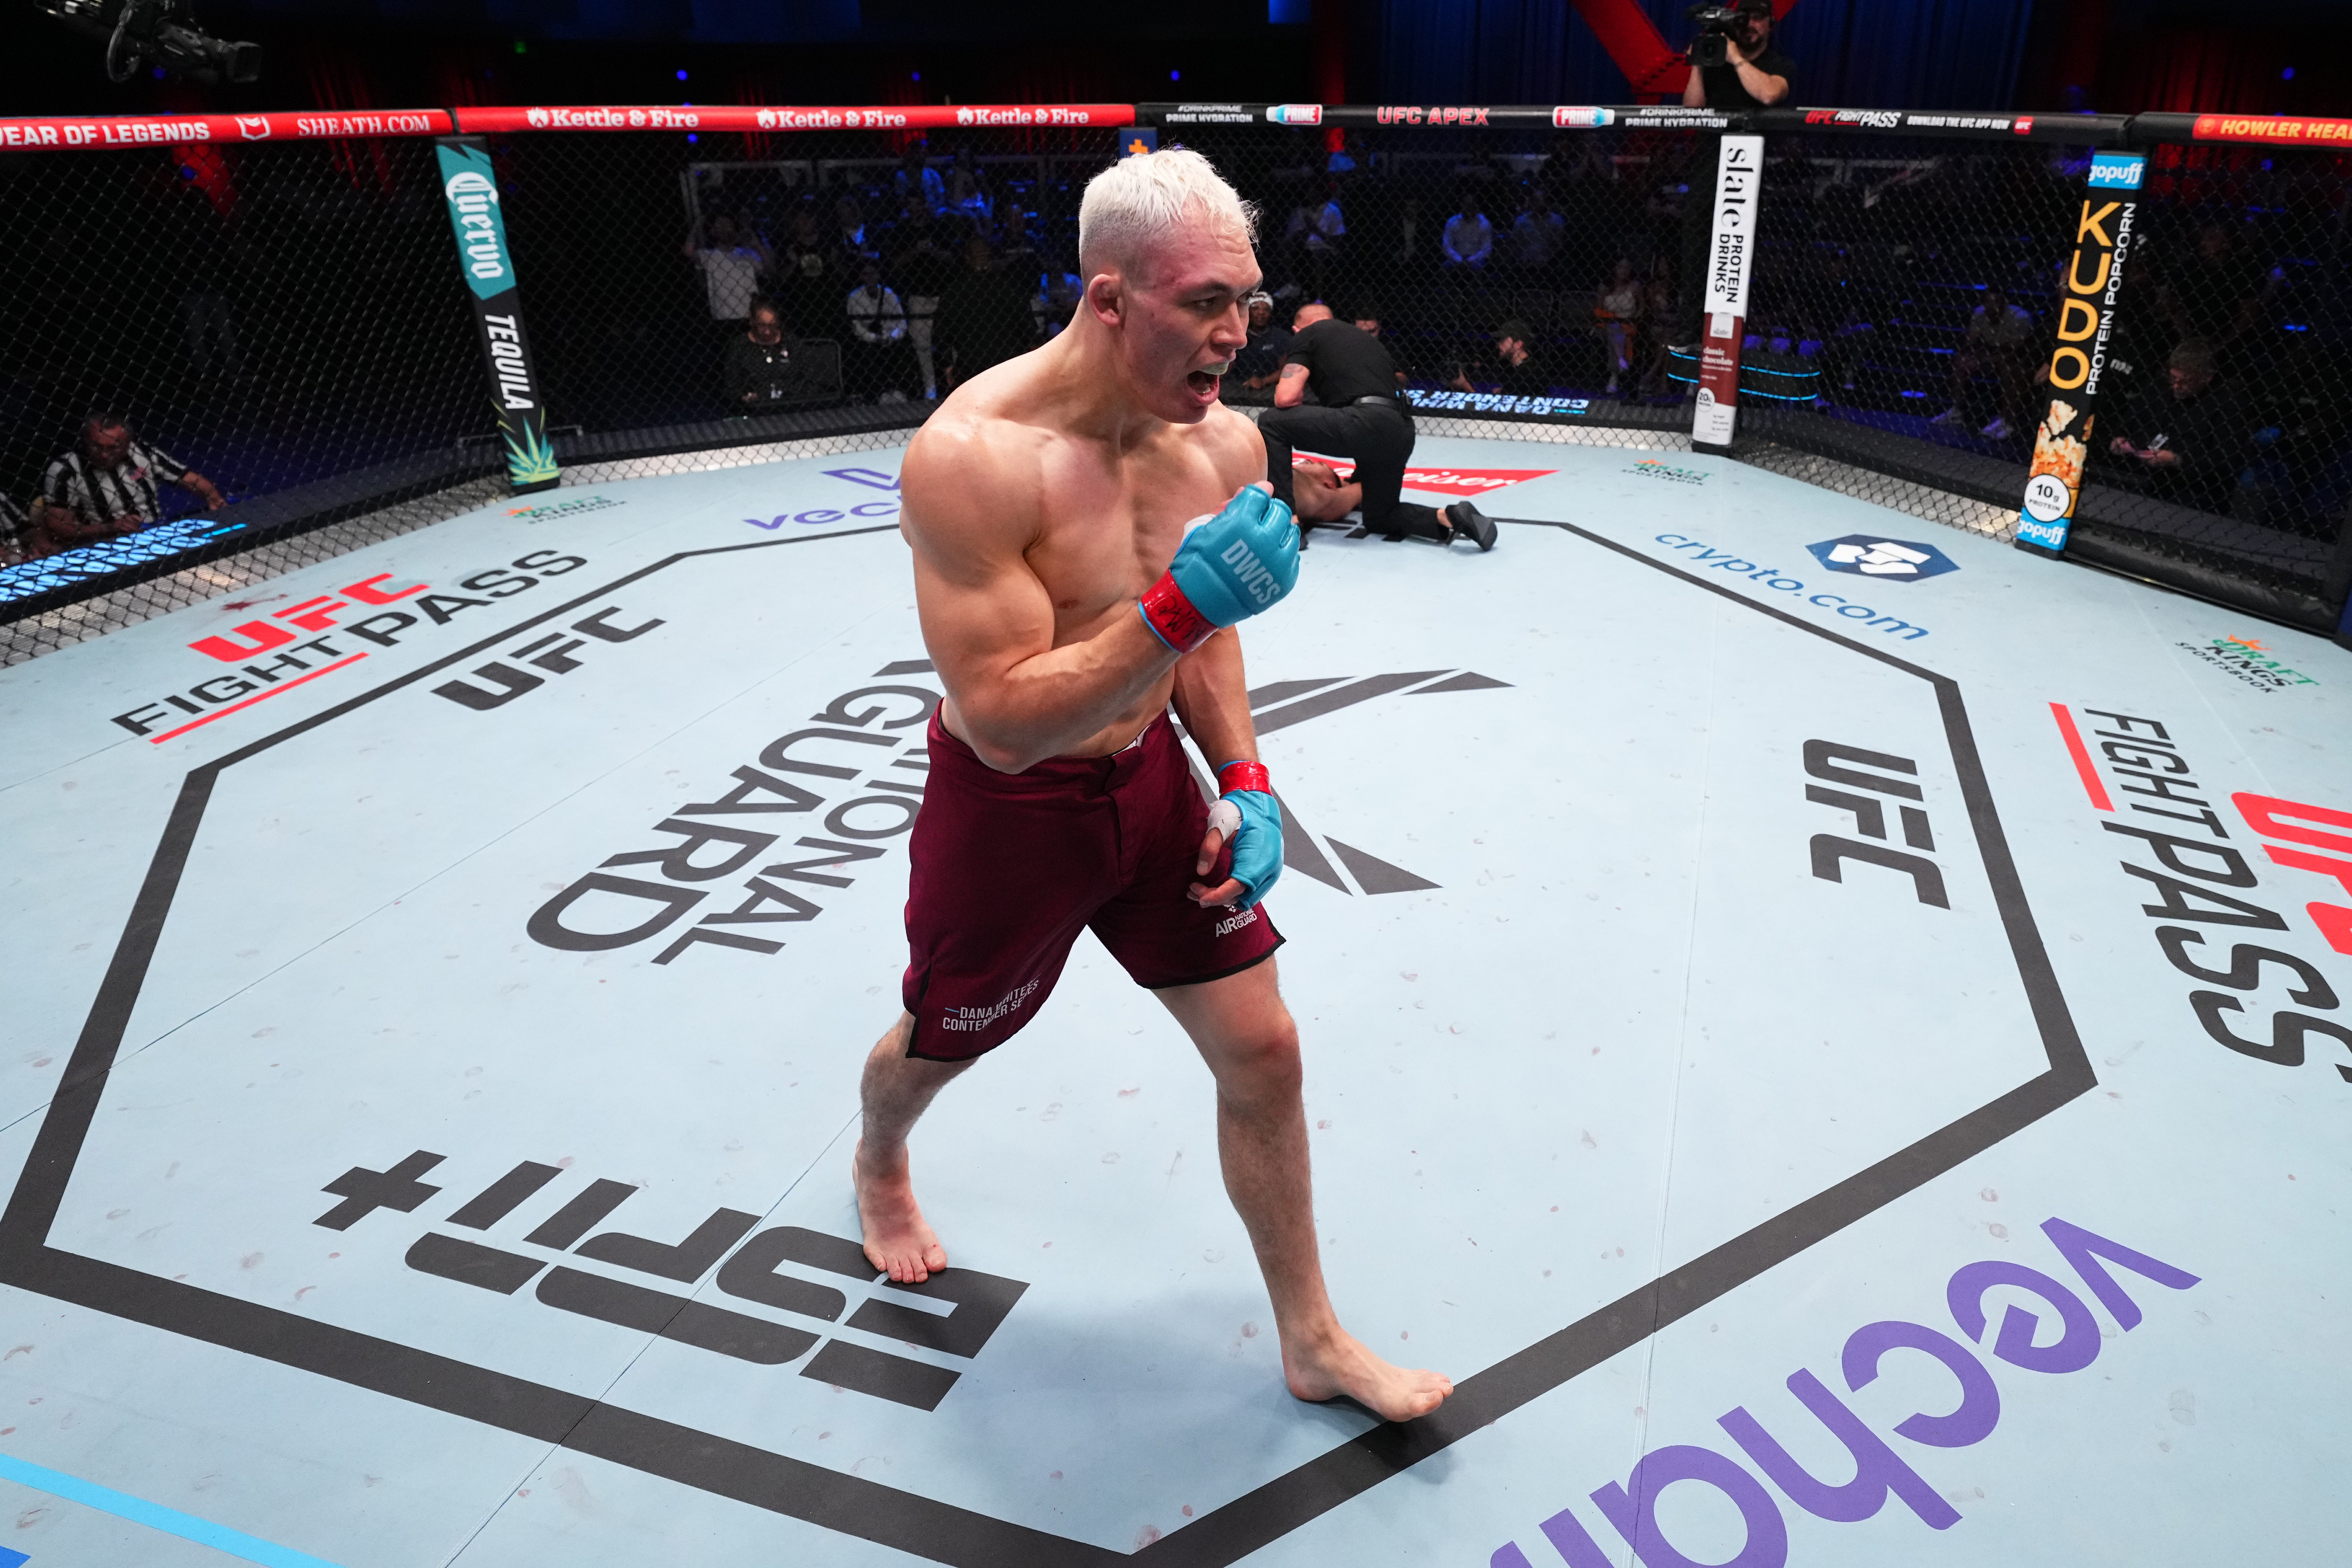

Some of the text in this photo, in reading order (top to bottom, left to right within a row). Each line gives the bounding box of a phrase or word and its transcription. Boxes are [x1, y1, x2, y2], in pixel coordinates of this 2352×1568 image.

[0, 122, 210, 146] EAR OF LEGENDS
[297, 115, 431, 137] SHEATH.COM
[550, 108, 699, 127] Kettle & Fire
[777, 110, 907, 128] Kettle & Fire
[975, 108, 1088, 125] Kettle & Fire
[1165, 113, 1253, 123] PRIME HYDRATION
[1284, 107, 1318, 122] PRIME
[1377, 106, 1489, 126] UFC APEX
[1561, 109, 1596, 125] PRIME
[1625, 118, 1728, 128] PRIME HYDRATION
[1805, 111, 1902, 128] UFC FIGHT PASS
[2220, 120, 2302, 138] HOWLER
[1721, 148, 1753, 227] slate
[446, 171, 504, 279] Cuervo
[1715, 234, 1730, 293] DRINKS
[1727, 235, 1744, 303] PROTEIN
[2049, 200, 2122, 390] KUDO
[2086, 203, 2137, 395] PROTEIN POPCORN
[485, 314, 534, 409] TEQUILA
[2029, 499, 2061, 512] PROTEIN
[1220, 538, 1281, 604] DWCS
[1655, 534, 1929, 640] crypto.com
[188, 572, 430, 663] UFC
[109, 550, 588, 737] FIGHT PASS
[430, 605, 667, 711] UFC
[2203, 646, 2293, 686] KINGS
[2212, 639, 2320, 685] DRAFT
[2174, 642, 2277, 693] SPORTSBOOK
[527, 685, 943, 952] GUARD
[1803, 739, 1951, 910] UFC
[651, 748, 930, 966] IONAL
[1235, 907, 1254, 921] NATIONAL
[2084, 708, 2352, 1083] FIGHT PASS
[1216, 917, 1238, 938] AIR
[1237, 913, 1257, 928] GUARD
[943, 1004, 1008, 1032] CONTENDER
[960, 1007, 992, 1019] DANA
[312, 1149, 1031, 1412] ESPN+
[1490, 1216, 2203, 1568] vecha
